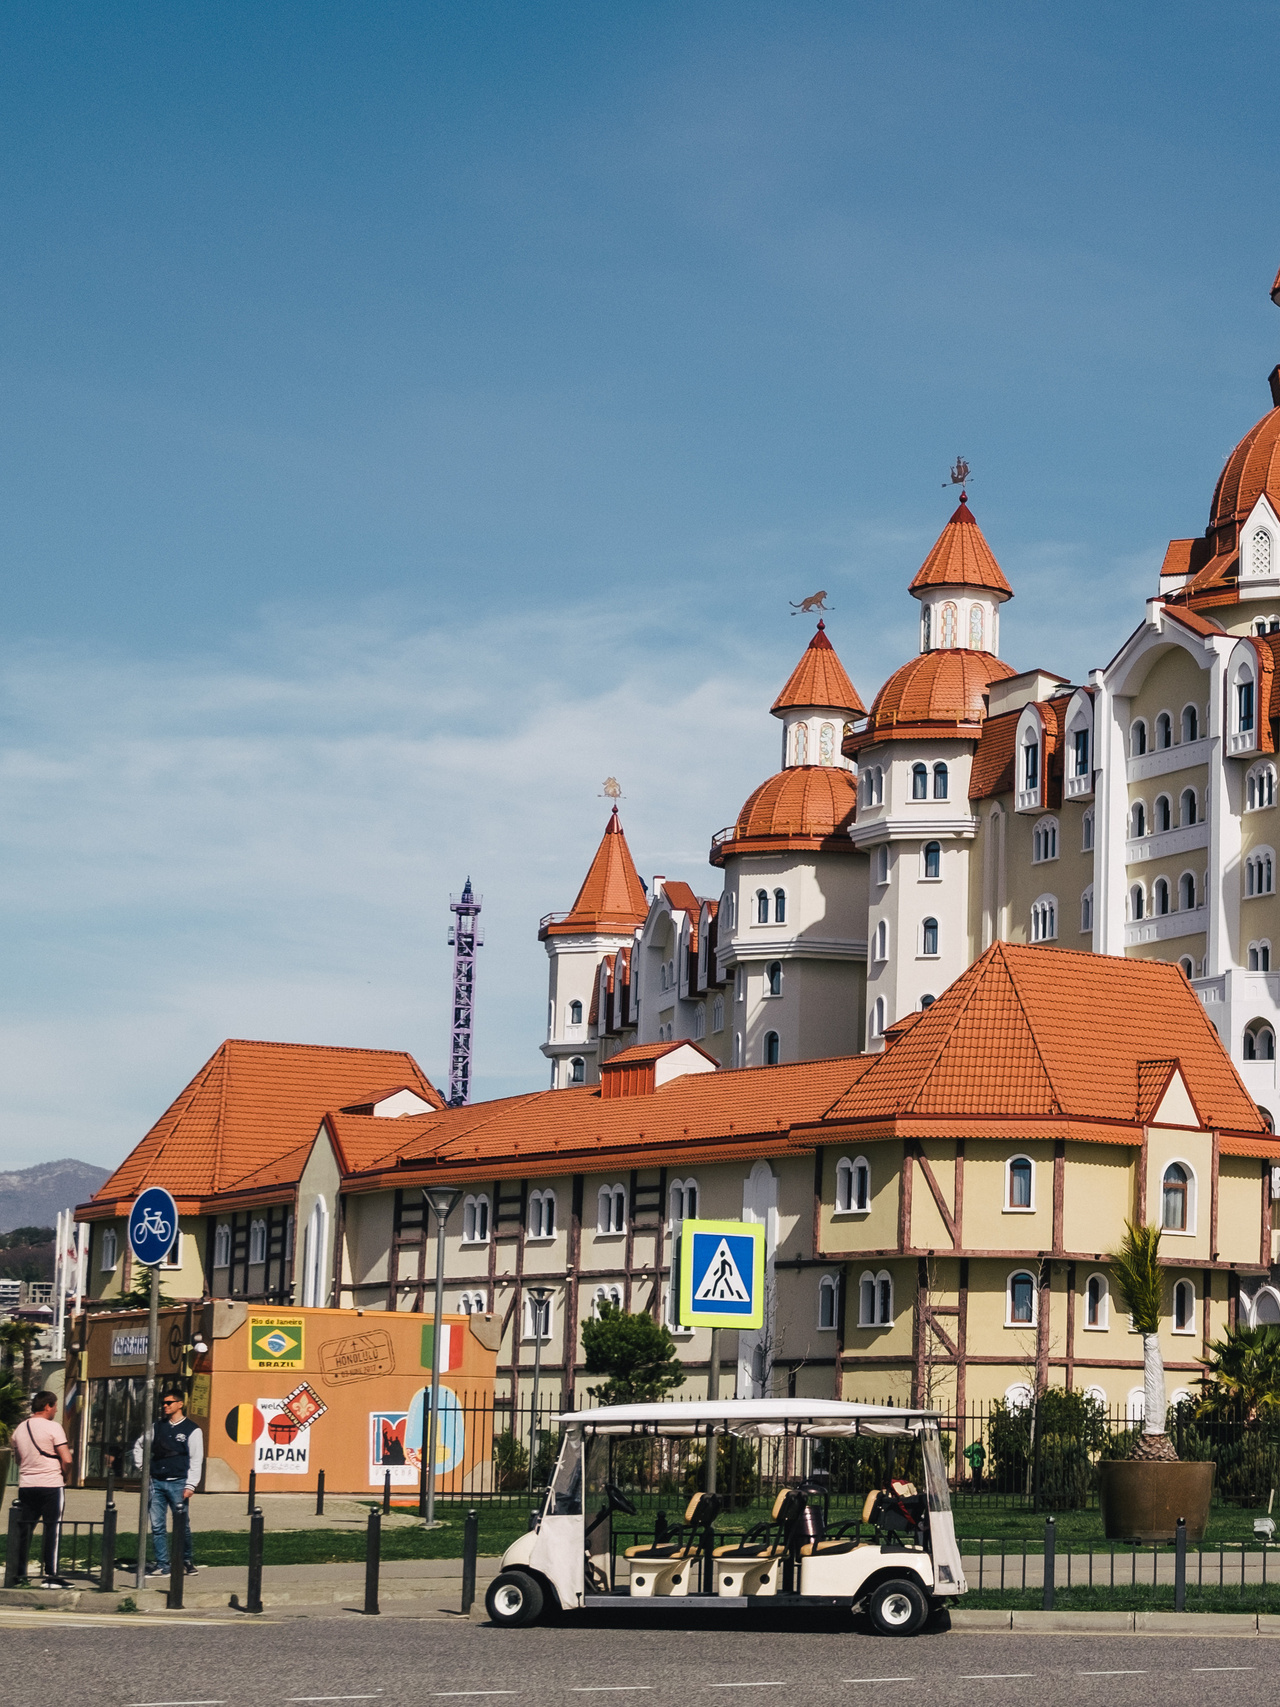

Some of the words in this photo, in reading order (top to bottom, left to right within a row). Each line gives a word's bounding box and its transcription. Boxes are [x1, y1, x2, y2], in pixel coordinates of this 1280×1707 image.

[276, 1318, 303, 1326] Janeiro
[336, 1349, 379, 1367] HONOLULU
[281, 1381, 308, 1407] FRANCE
[301, 1406, 328, 1432] FRANCE
[258, 1447, 307, 1462] JAPAN
